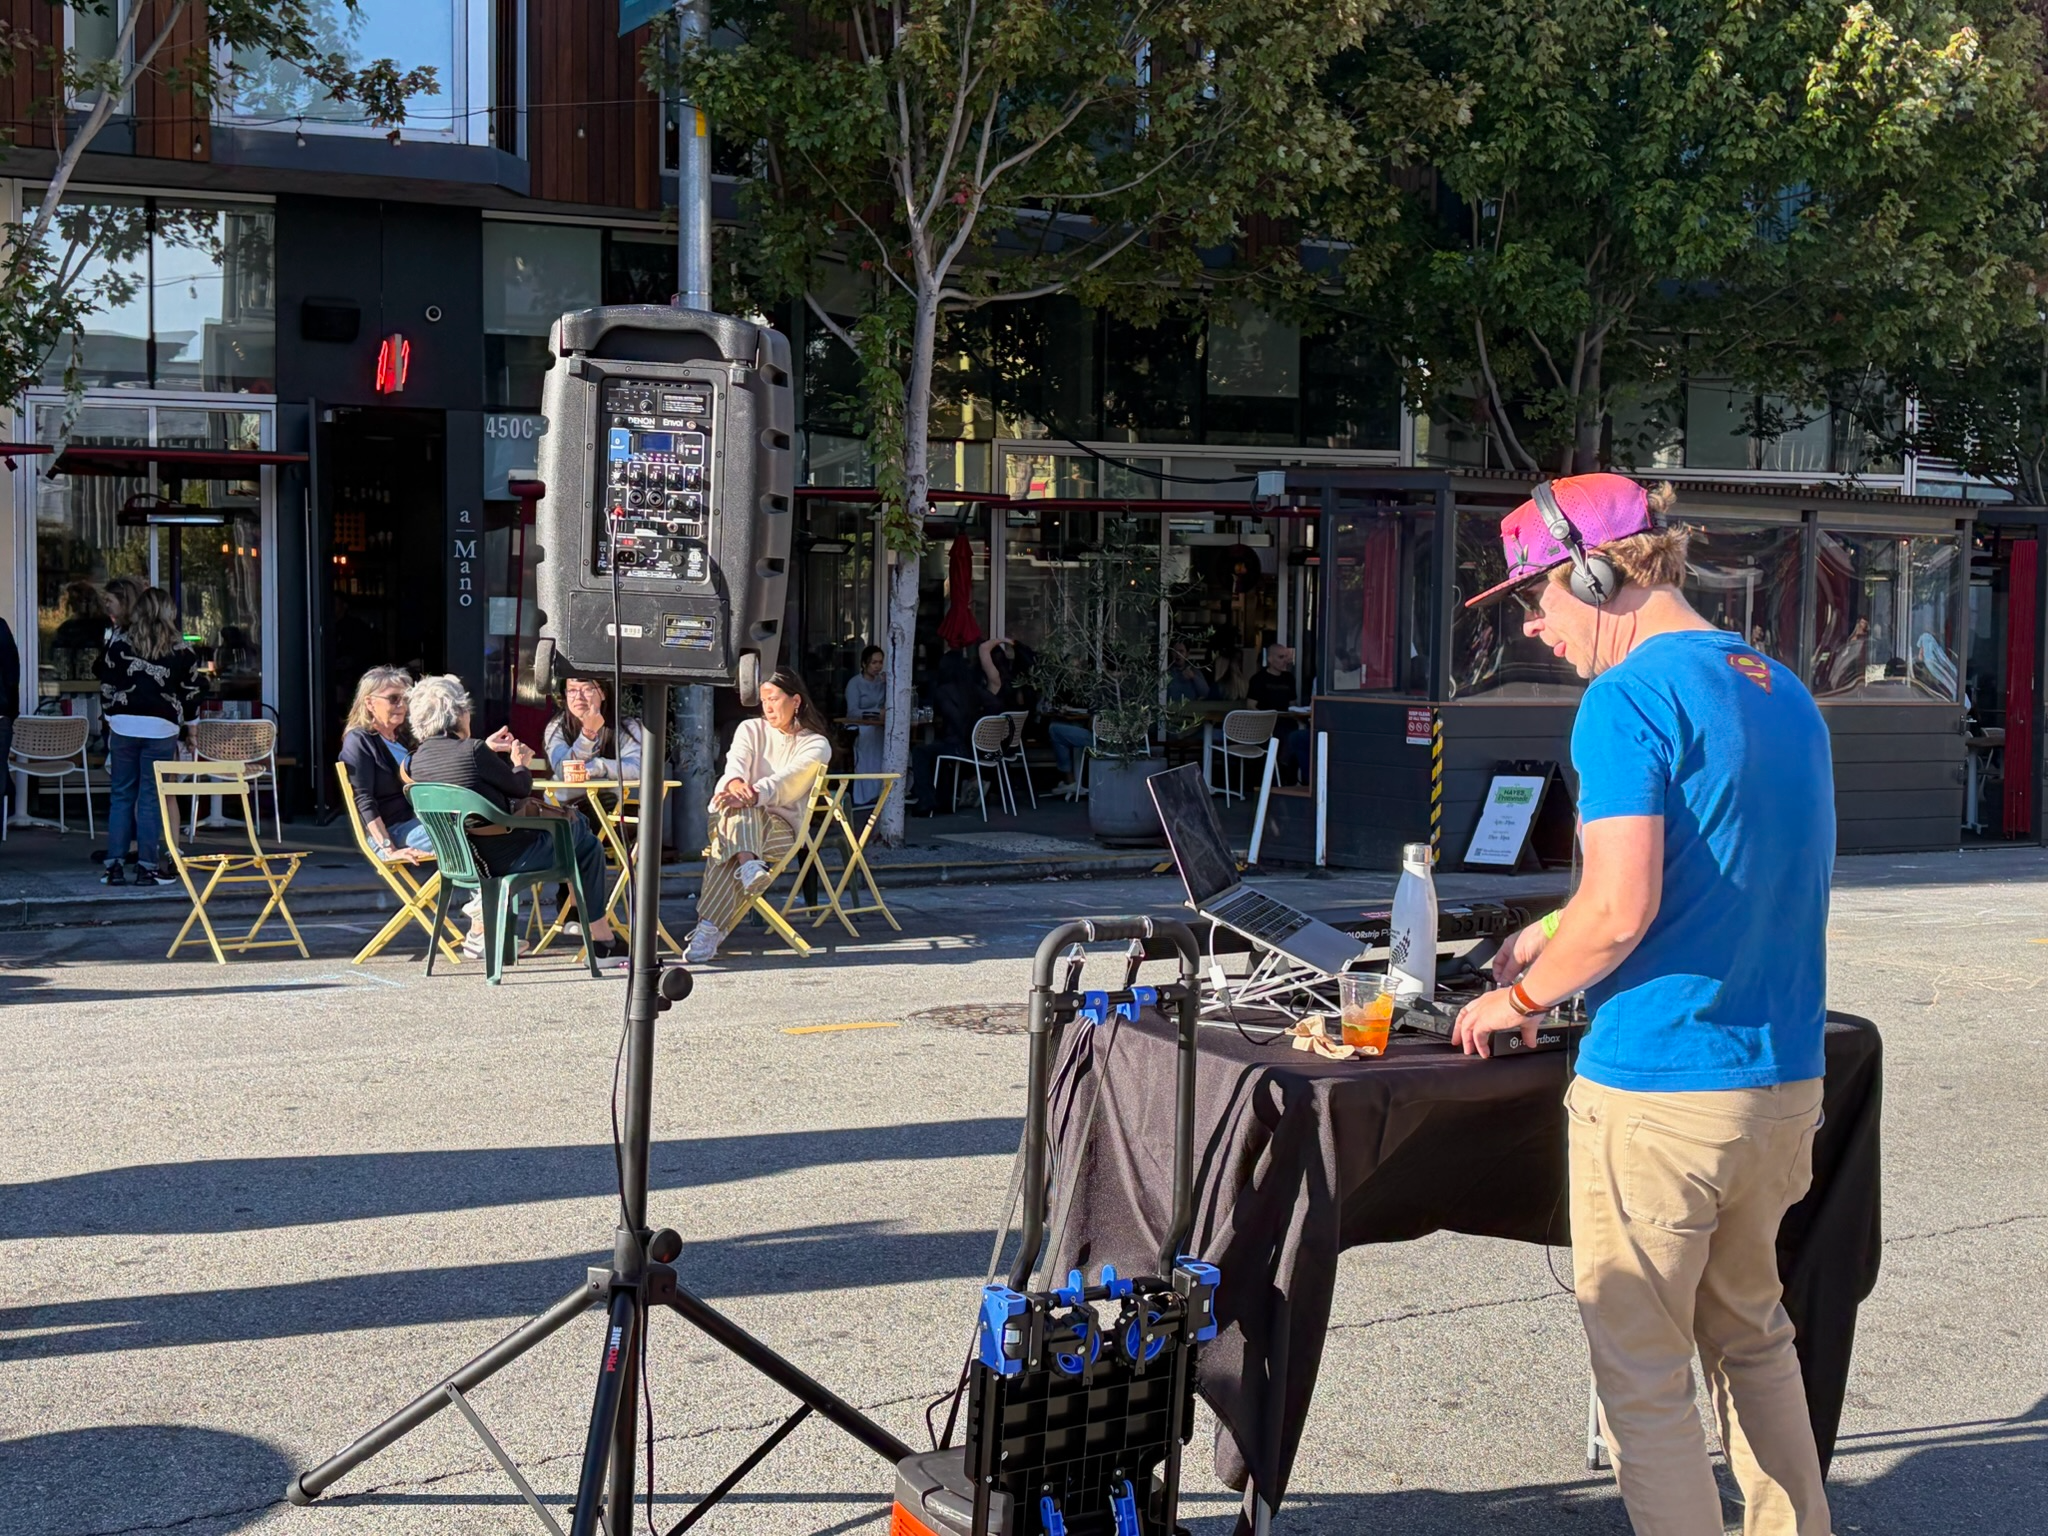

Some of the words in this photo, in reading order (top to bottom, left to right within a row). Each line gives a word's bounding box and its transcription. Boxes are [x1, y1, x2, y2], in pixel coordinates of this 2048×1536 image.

[486, 417, 549, 439] 450C-
[628, 417, 655, 425] DENON
[662, 418, 684, 427] Envoi
[459, 510, 471, 524] a
[453, 540, 478, 607] Mano
[606, 1326, 622, 1372] PROLINE
